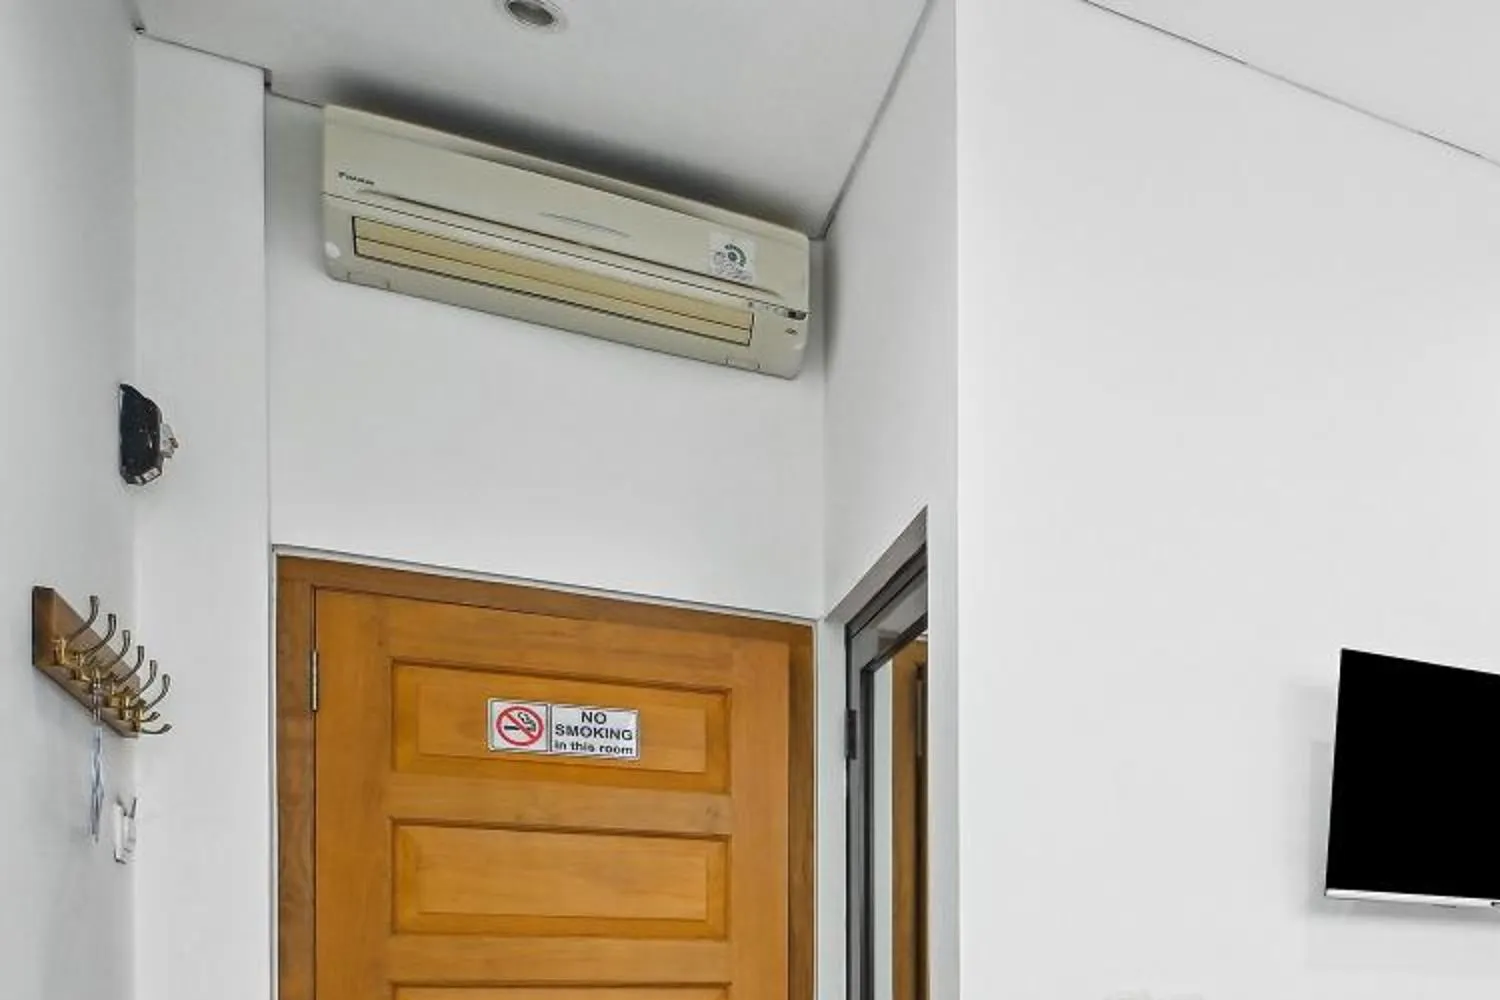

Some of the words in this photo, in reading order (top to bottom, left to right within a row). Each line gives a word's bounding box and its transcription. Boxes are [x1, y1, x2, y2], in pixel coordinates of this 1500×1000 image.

[581, 711, 607, 724] NO
[555, 724, 633, 740] SMOKING
[554, 739, 567, 750] in
[570, 741, 595, 752] this
[599, 744, 633, 755] room
